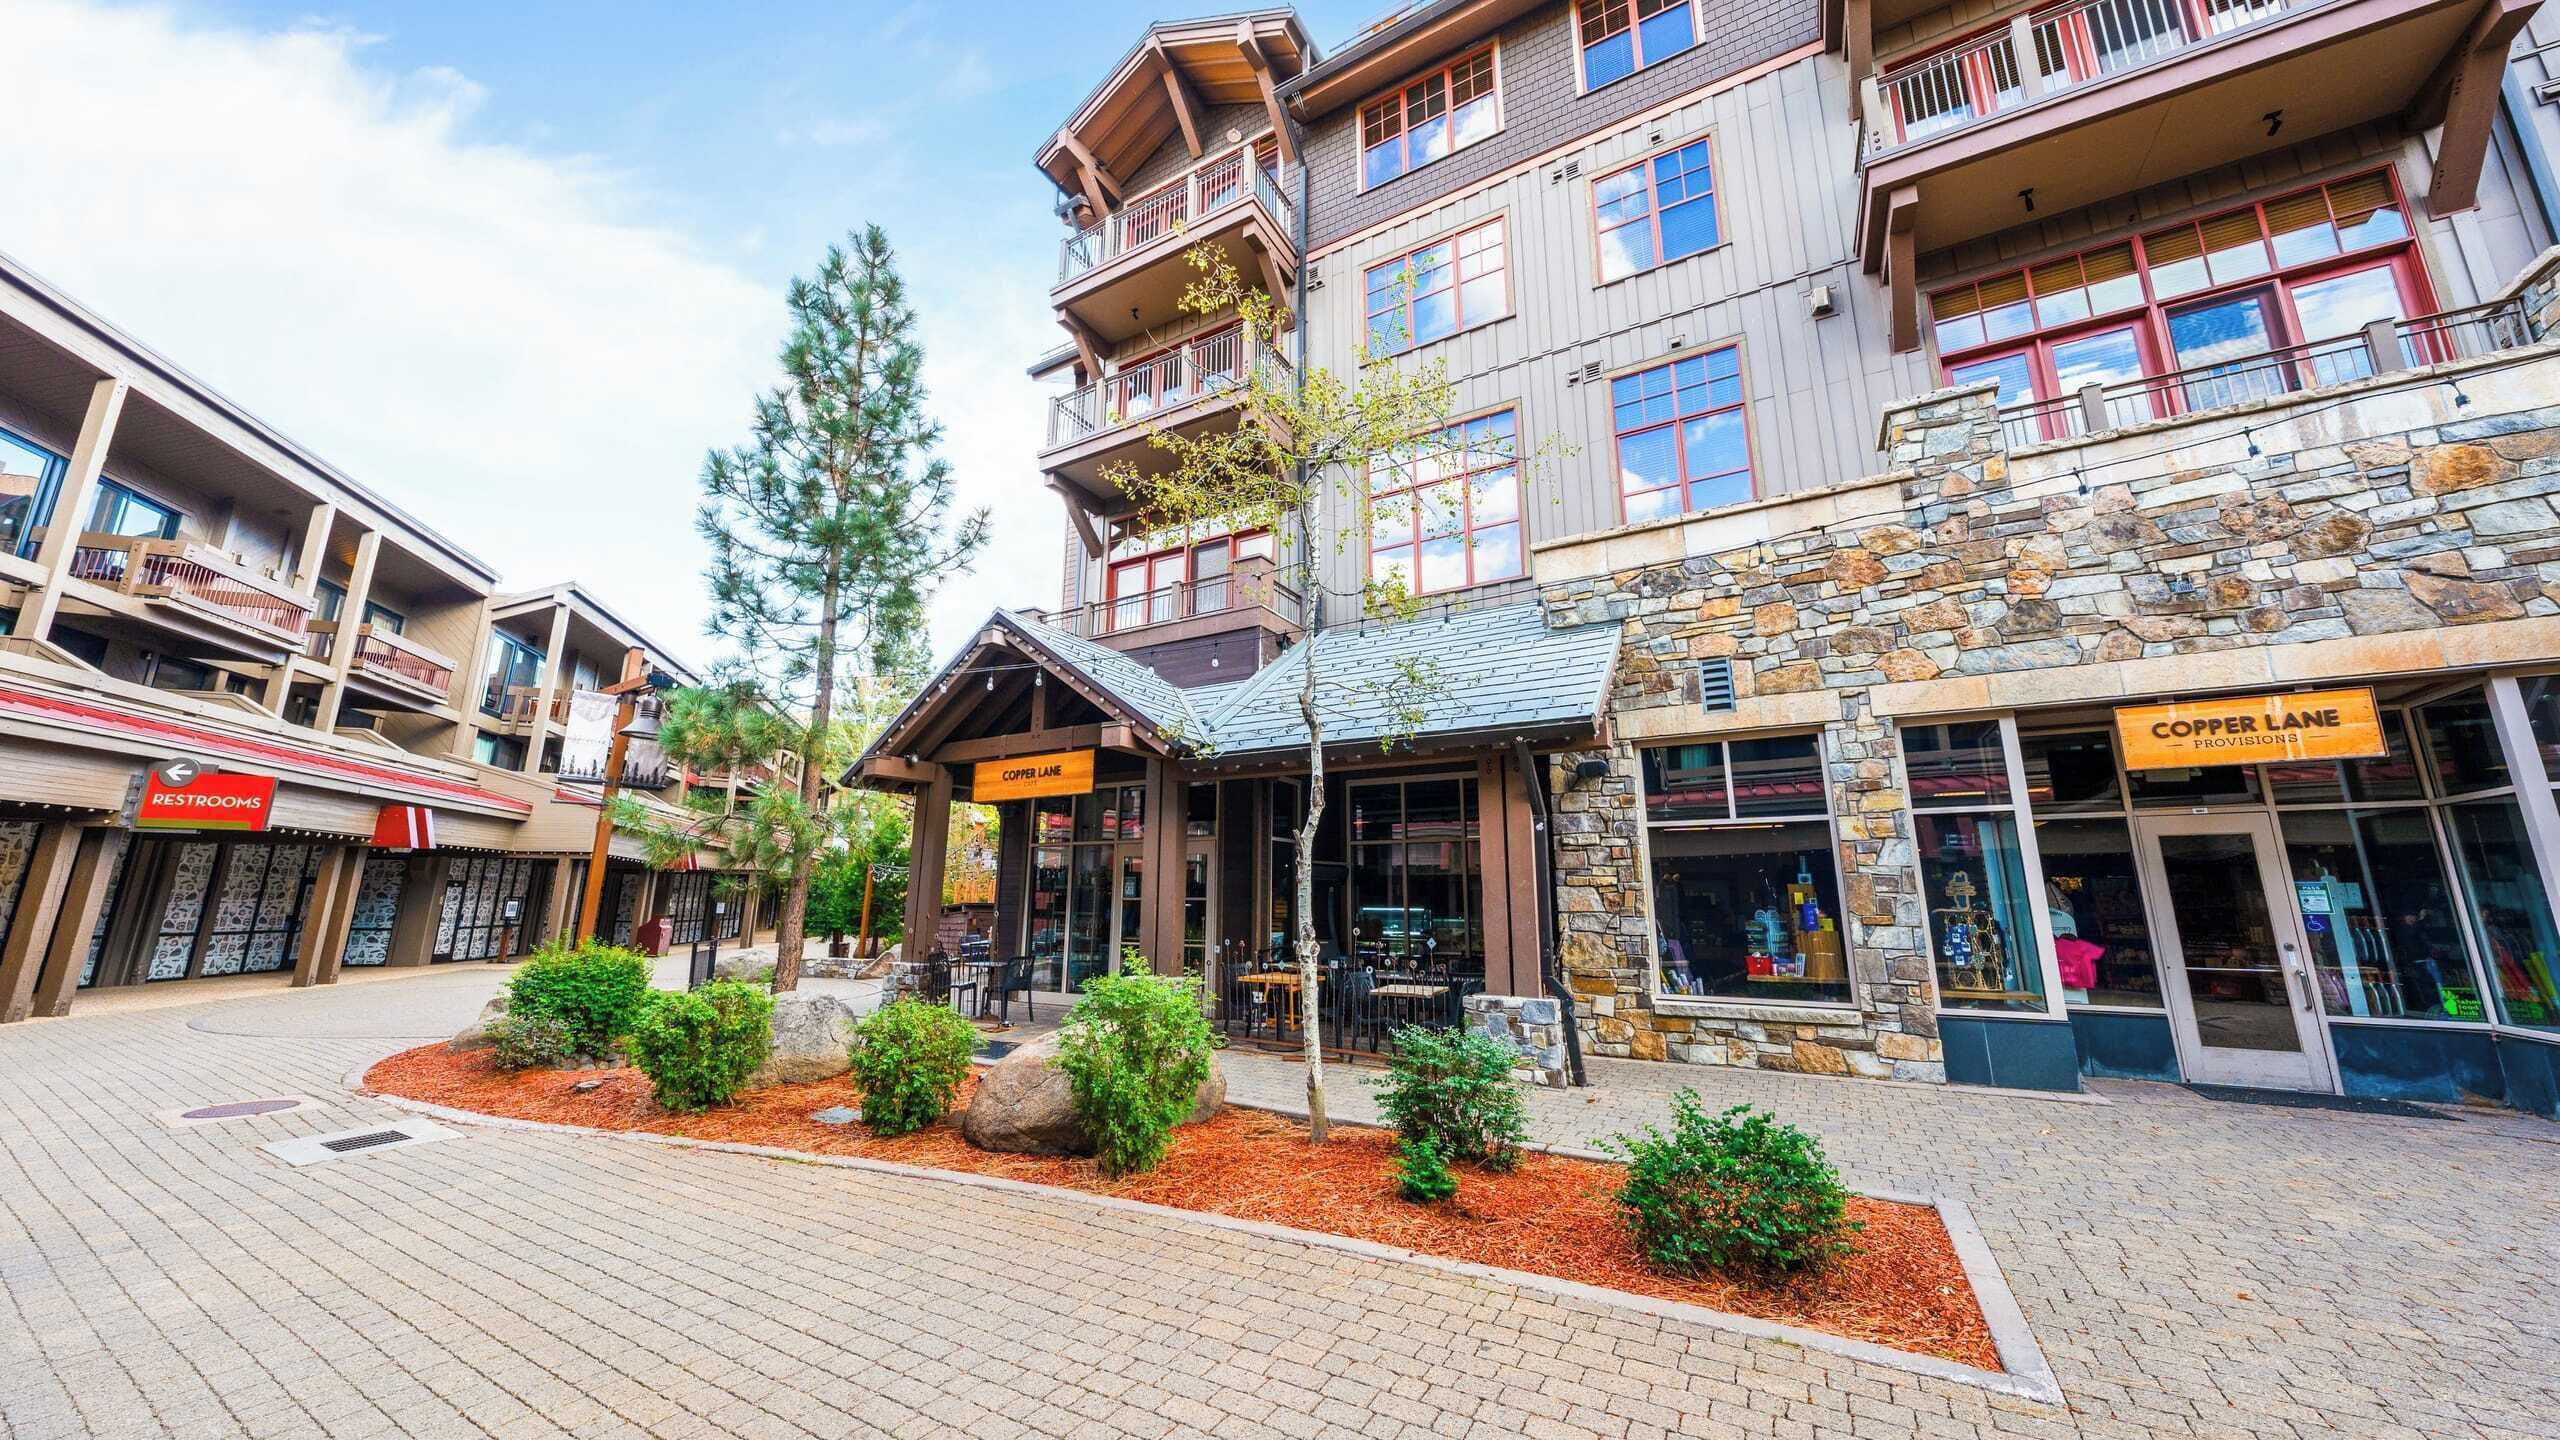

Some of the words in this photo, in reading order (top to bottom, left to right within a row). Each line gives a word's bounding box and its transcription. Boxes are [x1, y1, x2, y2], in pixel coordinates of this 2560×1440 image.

[2151, 714, 2258, 739] COPPER
[2264, 708, 2341, 732] LANE
[2193, 733, 2299, 749] PROVISIONS
[1002, 767, 1036, 781] COPPER
[1038, 764, 1062, 778] LANE
[151, 793, 261, 809] RESTROOMS
